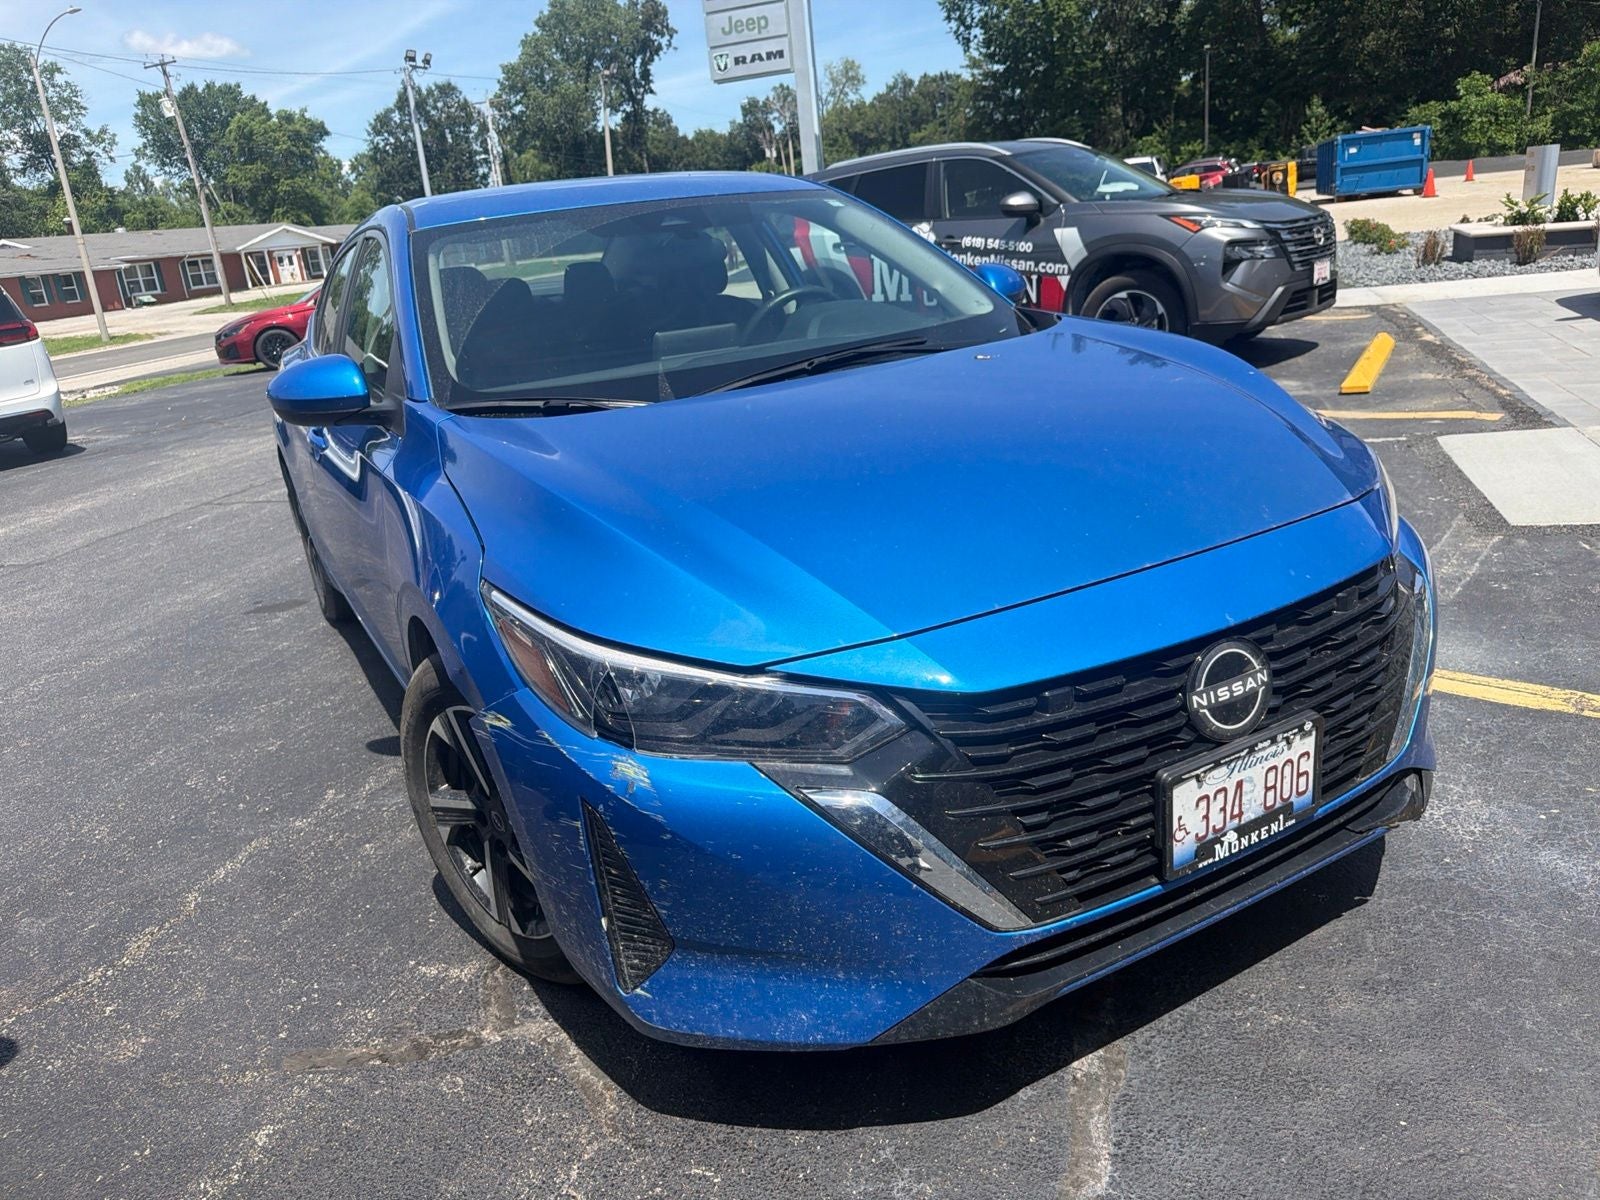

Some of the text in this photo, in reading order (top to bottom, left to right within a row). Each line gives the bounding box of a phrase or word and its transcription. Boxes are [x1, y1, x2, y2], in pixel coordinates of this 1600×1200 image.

[721, 15, 769, 36] Jeep
[733, 49, 785, 66] RAM
[961, 236, 1033, 253] (618) 545-5100
[947, 250, 1069, 275] onkenNissan.com
[1192, 669, 1268, 709] NISSAN
[1195, 751, 1311, 843] 334 806
